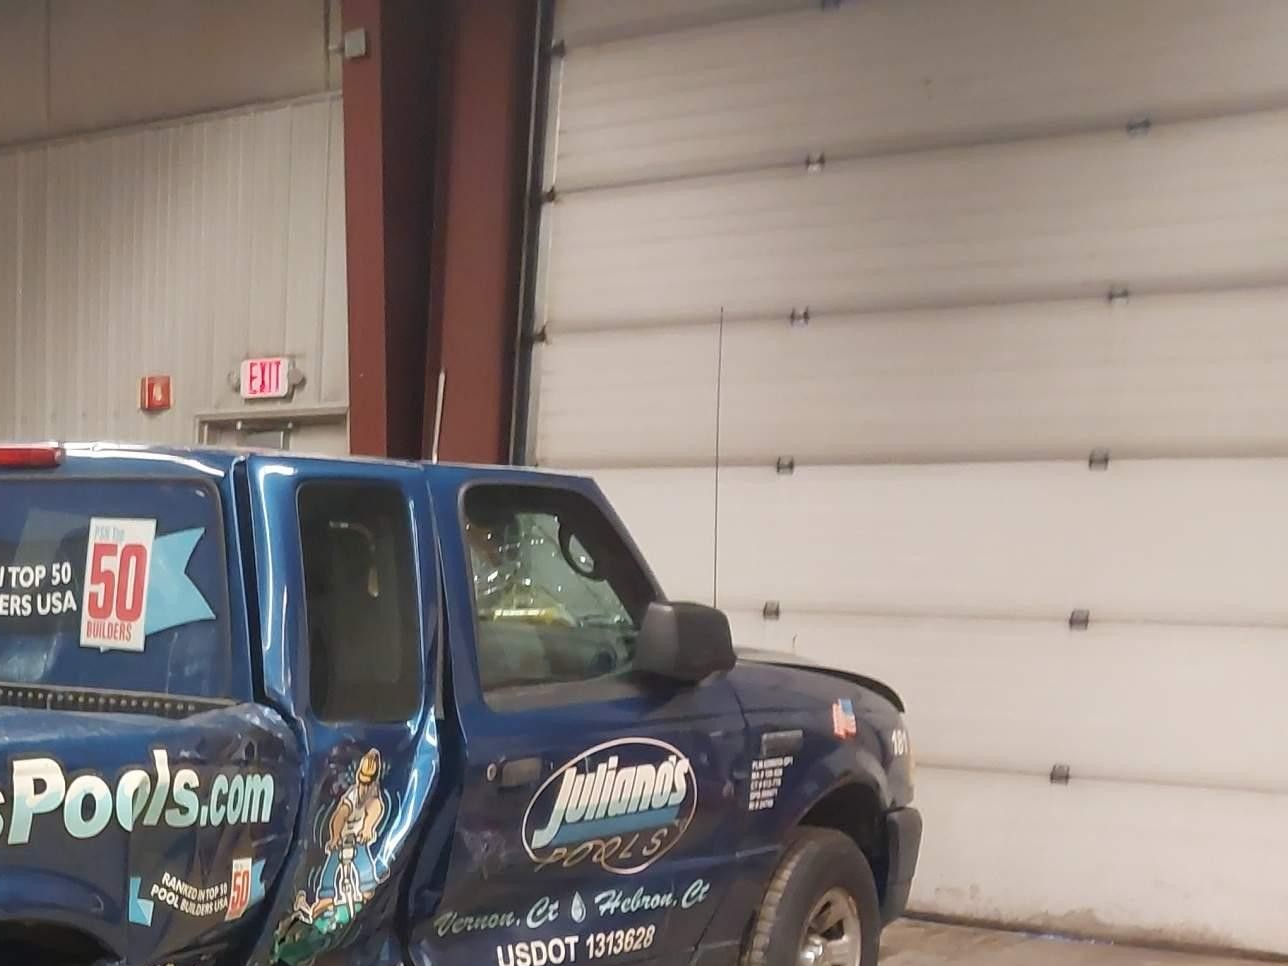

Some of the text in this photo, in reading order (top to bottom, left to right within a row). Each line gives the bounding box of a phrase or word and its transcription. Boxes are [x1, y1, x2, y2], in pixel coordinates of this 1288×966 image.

[249, 360, 281, 394] EXIT
[8, 564, 46, 588] TOP
[51, 561, 72, 586] 50
[88, 543, 147, 622] 50
[36, 589, 77, 616] USA
[86, 621, 132, 641] BUILDERS
[531, 754, 690, 850] Juliano's
[533, 827, 668, 873] POOLS
[150, 884, 179, 909] POOL
[180, 899, 214, 916] BUILDERS
[214, 896, 228, 912] USA
[161, 872, 197, 900] RANKED
[206, 886, 219, 902] TOP
[231, 870, 249, 910] 50
[586, 924, 655, 960] 1313628
